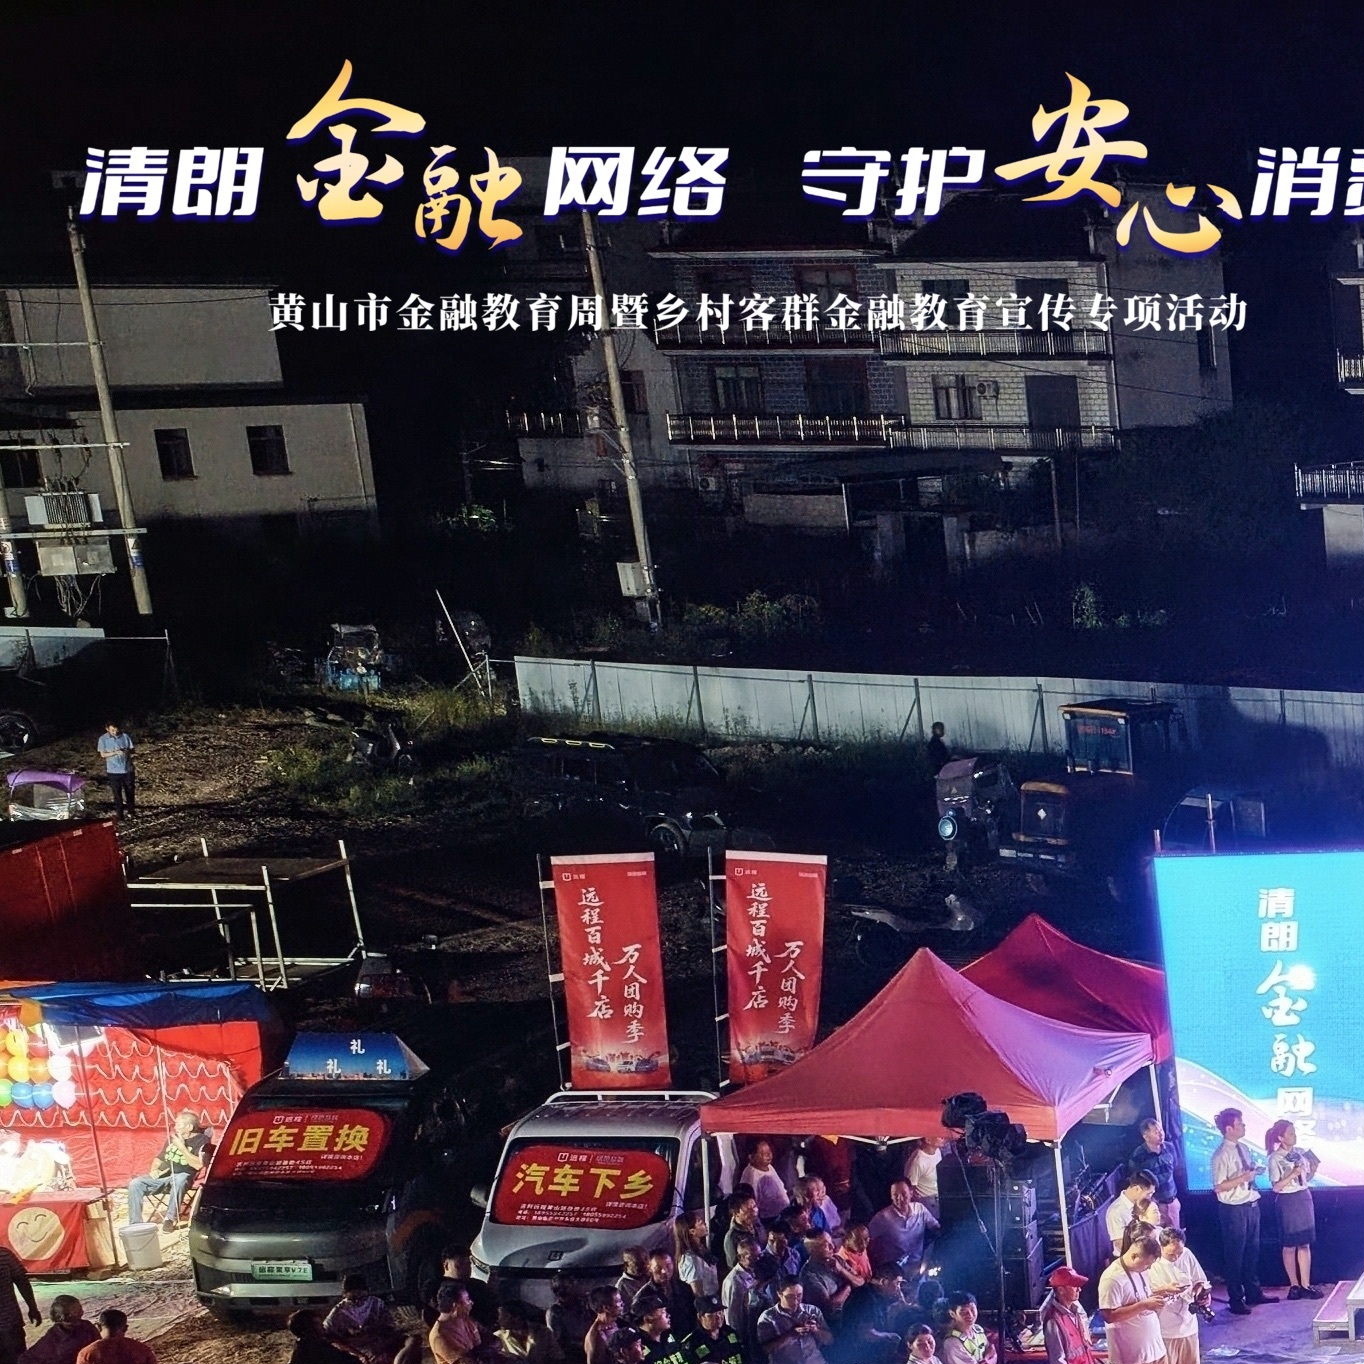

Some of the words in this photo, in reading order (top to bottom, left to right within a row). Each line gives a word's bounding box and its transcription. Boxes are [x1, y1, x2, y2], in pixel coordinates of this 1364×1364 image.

[577, 887, 614, 1020] 远程百城千店
[743, 882, 774, 1011] 远程百城千店
[612, 943, 648, 1044] 万人团购季
[773, 940, 806, 1034] 万人团购季
[326, 1058, 342, 1074] 礼
[376, 1059, 392, 1075] 礼
[350, 1038, 366, 1055] 礼
[229, 1123, 370, 1156] 旧车置换
[511, 1162, 655, 1200] 汽车下乡
